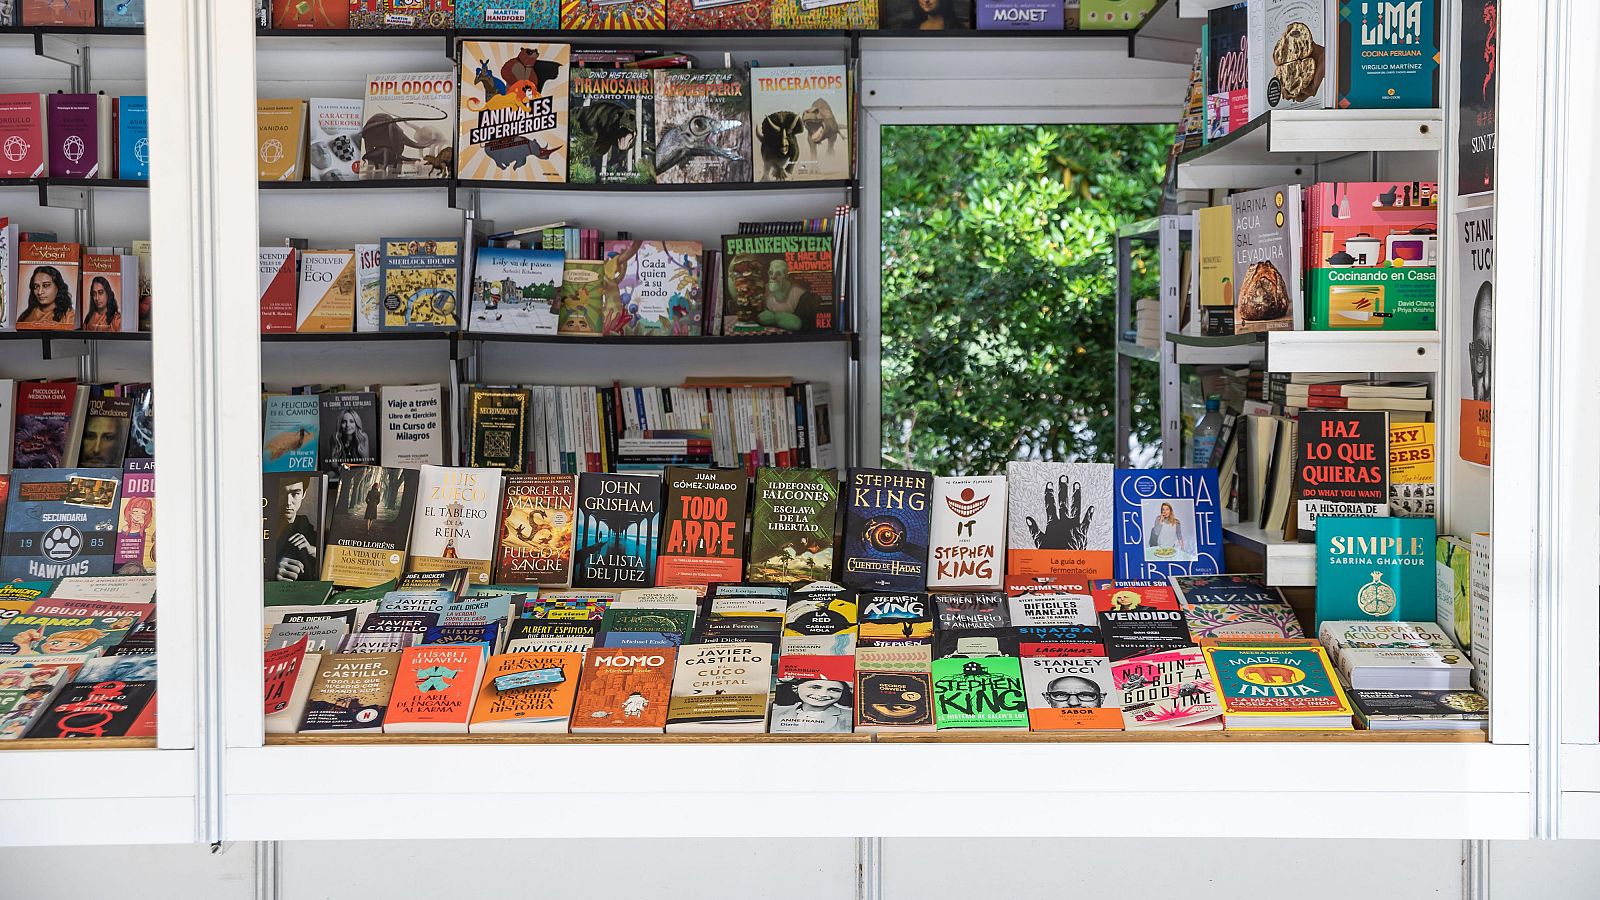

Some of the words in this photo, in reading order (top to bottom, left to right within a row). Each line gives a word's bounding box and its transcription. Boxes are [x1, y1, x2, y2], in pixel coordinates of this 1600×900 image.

[993, 9, 1046, 21] MONET
[1362, 1, 1422, 44] LIMA
[370, 80, 453, 95] DIPLODOCO
[758, 76, 842, 91] TRICERATOPS
[320, 111, 359, 119] CARÁCTER
[480, 99, 550, 127] ANIMALES
[472, 115, 555, 143] SUPERHÉROES
[1472, 135, 1486, 153] SUN
[1236, 197, 1268, 212] HARINA
[1236, 218, 1260, 230] AGUA
[727, 236, 832, 254] FRANKENSTEIN
[1237, 234, 1252, 247] SAL
[40, 251, 65, 260] Yogui
[1238, 246, 1284, 264] LEVADURA
[642, 260, 665, 268] Cada
[788, 261, 832, 271] SANDWICH
[304, 272, 333, 282] EGO
[640, 270, 666, 279] quien
[1328, 270, 1388, 281] Cocinando
[1391, 273, 1404, 281] en
[1408, 270, 1436, 281] Casa
[641, 289, 667, 297] modo
[816, 319, 831, 328] REX
[427, 421, 436, 429] de
[1321, 421, 1360, 438] HAZ
[396, 432, 430, 441] Milagros
[1307, 443, 1331, 460] LO
[1337, 443, 1376, 464] QUE
[289, 457, 313, 468] DYER
[855, 474, 926, 488] STEPHEN
[1303, 466, 1381, 486] QUIERAS
[600, 481, 640, 495] JOHN
[673, 480, 737, 491] GÓMEZ-JURADO
[769, 482, 823, 490] ILDEFONSO
[763, 490, 829, 502] FALCONES
[1303, 489, 1315, 498] (DO
[1317, 489, 1340, 497] WHAT
[1341, 489, 1356, 497] YOU
[1358, 489, 1382, 498] WANT)
[506, 496, 572, 510] MARTIN
[585, 497, 654, 513] GRISHAM
[854, 488, 925, 511] KING
[425, 507, 435, 516] EL
[439, 507, 487, 519] TABLERO
[681, 496, 727, 520] TODO
[773, 506, 815, 514] ESCLAVA
[1305, 504, 1316, 512] LA
[1320, 504, 1362, 513] HISTORIA
[1366, 505, 1377, 514] DE
[796, 515, 809, 523] LA
[435, 528, 471, 538] REINA
[768, 523, 819, 532] LIBERTAD
[957, 520, 977, 537] IT
[20, 539, 32, 547] 19
[91, 538, 103, 546] 85
[667, 520, 736, 555] ARDE
[338, 539, 362, 547] CHUFO
[364, 540, 395, 549] LLORÉNS
[1330, 535, 1424, 556] SIMPLE
[354, 550, 370, 558] VIDA
[934, 544, 994, 559] STEPHEN
[357, 558, 385, 567] SEPARA
[511, 559, 563, 571] SANGRE
[589, 554, 606, 565] LA
[609, 555, 644, 567] LISTA
[1061, 558, 1075, 567] guía
[1330, 557, 1372, 565] SABRINA
[1377, 558, 1425, 566] GHAYOUR
[29, 560, 89, 578] HAWKINS
[937, 560, 993, 580] KING
[587, 568, 610, 580] DEL
[613, 570, 645, 582] JUEZ
[1194, 593, 1275, 603] BAZAR
[34, 606, 87, 616] DIBUJO
[864, 602, 924, 617] KING
[1024, 602, 1077, 610] DIFÍCILES
[1025, 608, 1078, 616] MANEJAR
[1104, 612, 1182, 621] VENDIDO
[11, 617, 95, 626] MANGA
[939, 614, 1001, 624] CEMENTERIO
[522, 626, 554, 634] ALBERT
[556, 626, 593, 635] ESPINOSA
[697, 649, 752, 657] JAVIER
[334, 662, 382, 670] JAVIER
[594, 655, 665, 667] MOMO
[685, 656, 762, 665] CASTILLO
[1229, 657, 1280, 666] MADE
[1282, 657, 1302, 666] IN
[322, 669, 389, 678] CASTILLO
[698, 668, 745, 677] CUCO
[692, 679, 748, 688] CRISTAL
[934, 677, 1022, 693] STEPHEN
[1124, 687, 1170, 704] GOOD
[1237, 684, 1320, 696] INDIA
[938, 690, 1027, 715] KING
[1172, 692, 1212, 709] TIME
